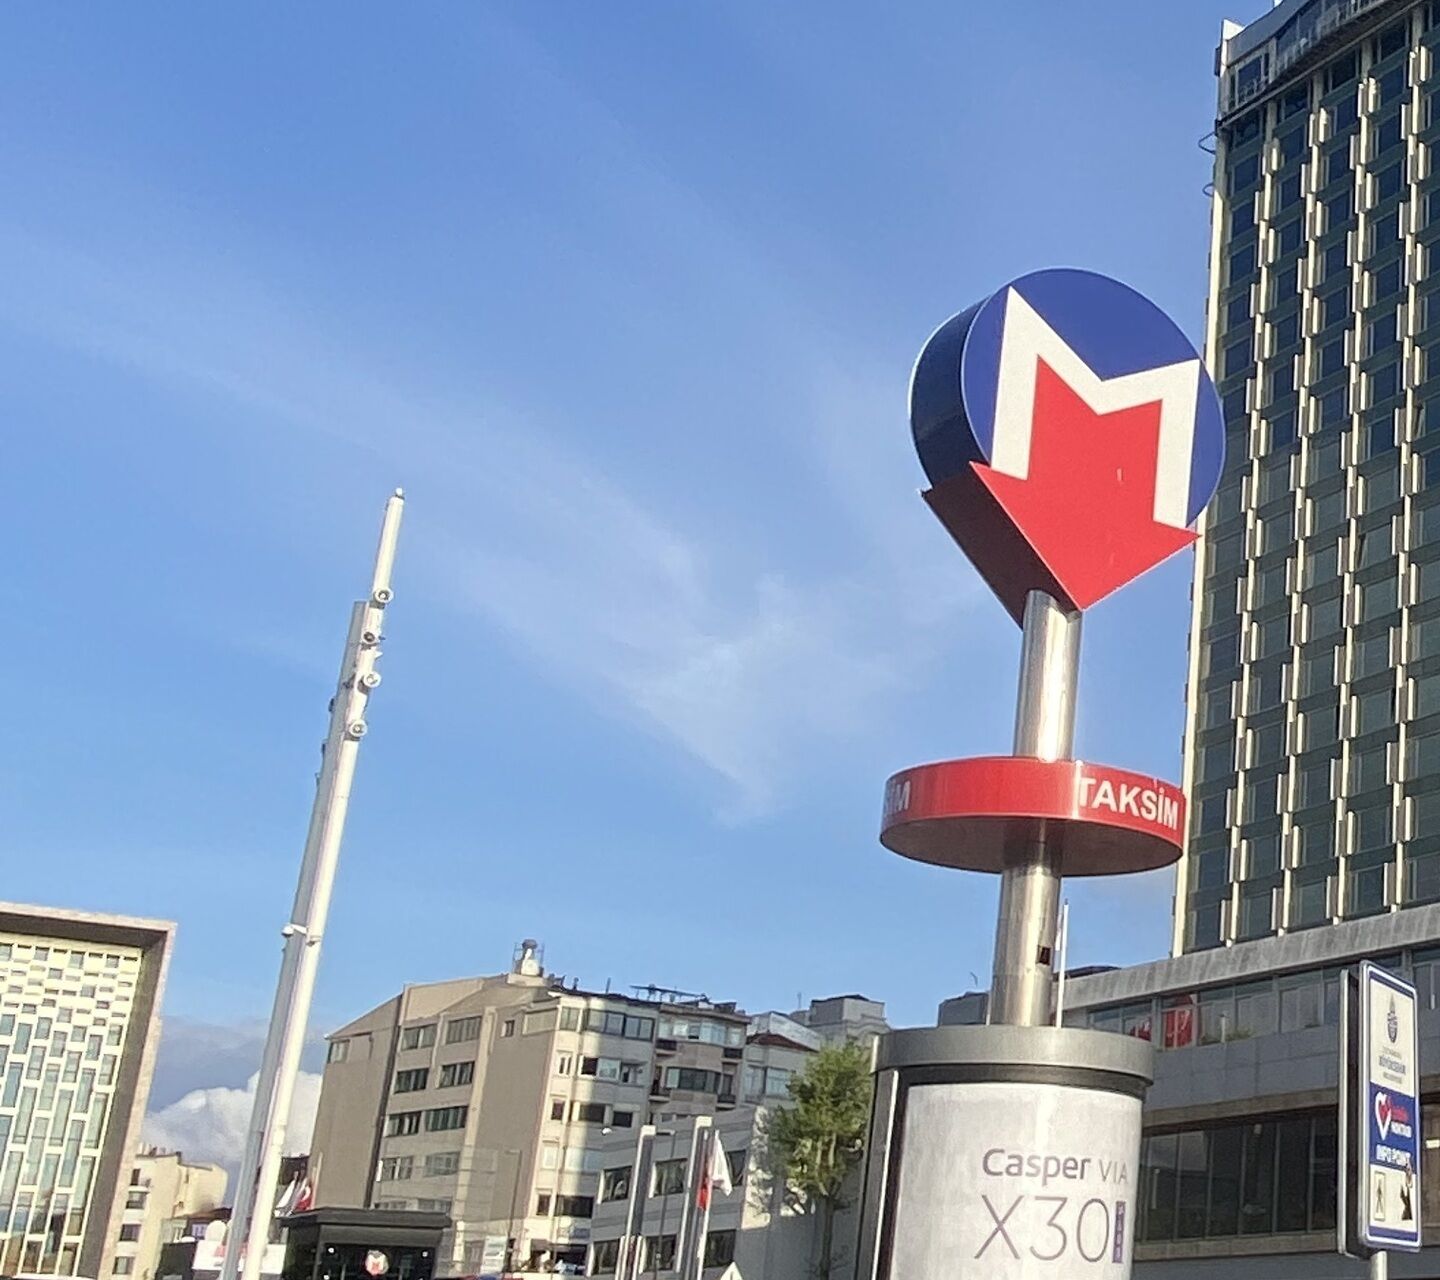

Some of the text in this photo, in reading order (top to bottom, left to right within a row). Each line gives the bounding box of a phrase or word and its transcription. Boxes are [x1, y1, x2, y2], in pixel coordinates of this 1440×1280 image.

[1079, 777, 1179, 831] TAKSİM
[982, 1148, 1128, 1187] Casper VIA
[974, 1194, 1110, 1263] X30
